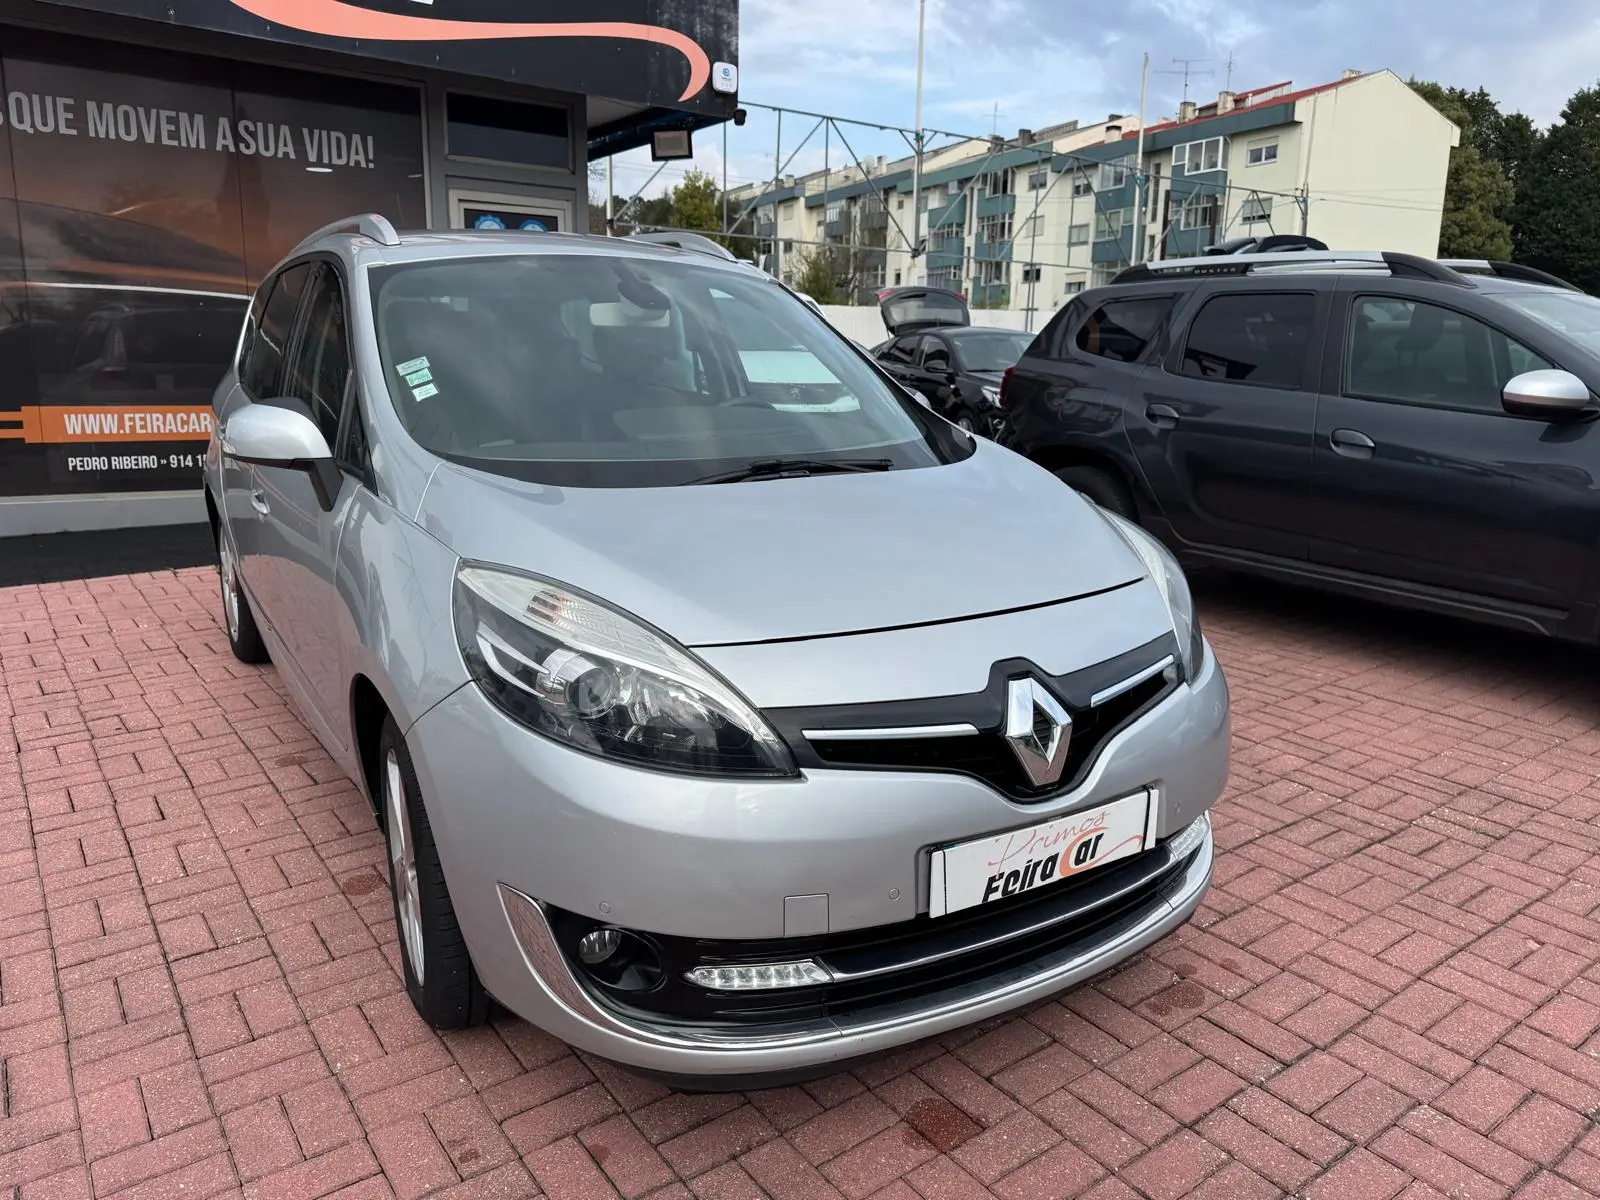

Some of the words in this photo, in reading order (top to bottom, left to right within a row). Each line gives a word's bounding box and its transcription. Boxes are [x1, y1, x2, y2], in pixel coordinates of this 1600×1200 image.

[8, 91, 77, 136] QUE
[86, 100, 206, 150] MOVEM
[302, 127, 375, 169] VIDA!
[68, 456, 108, 471] PEDRO
[111, 455, 158, 470] RIBEIRO
[170, 454, 193, 468] 914
